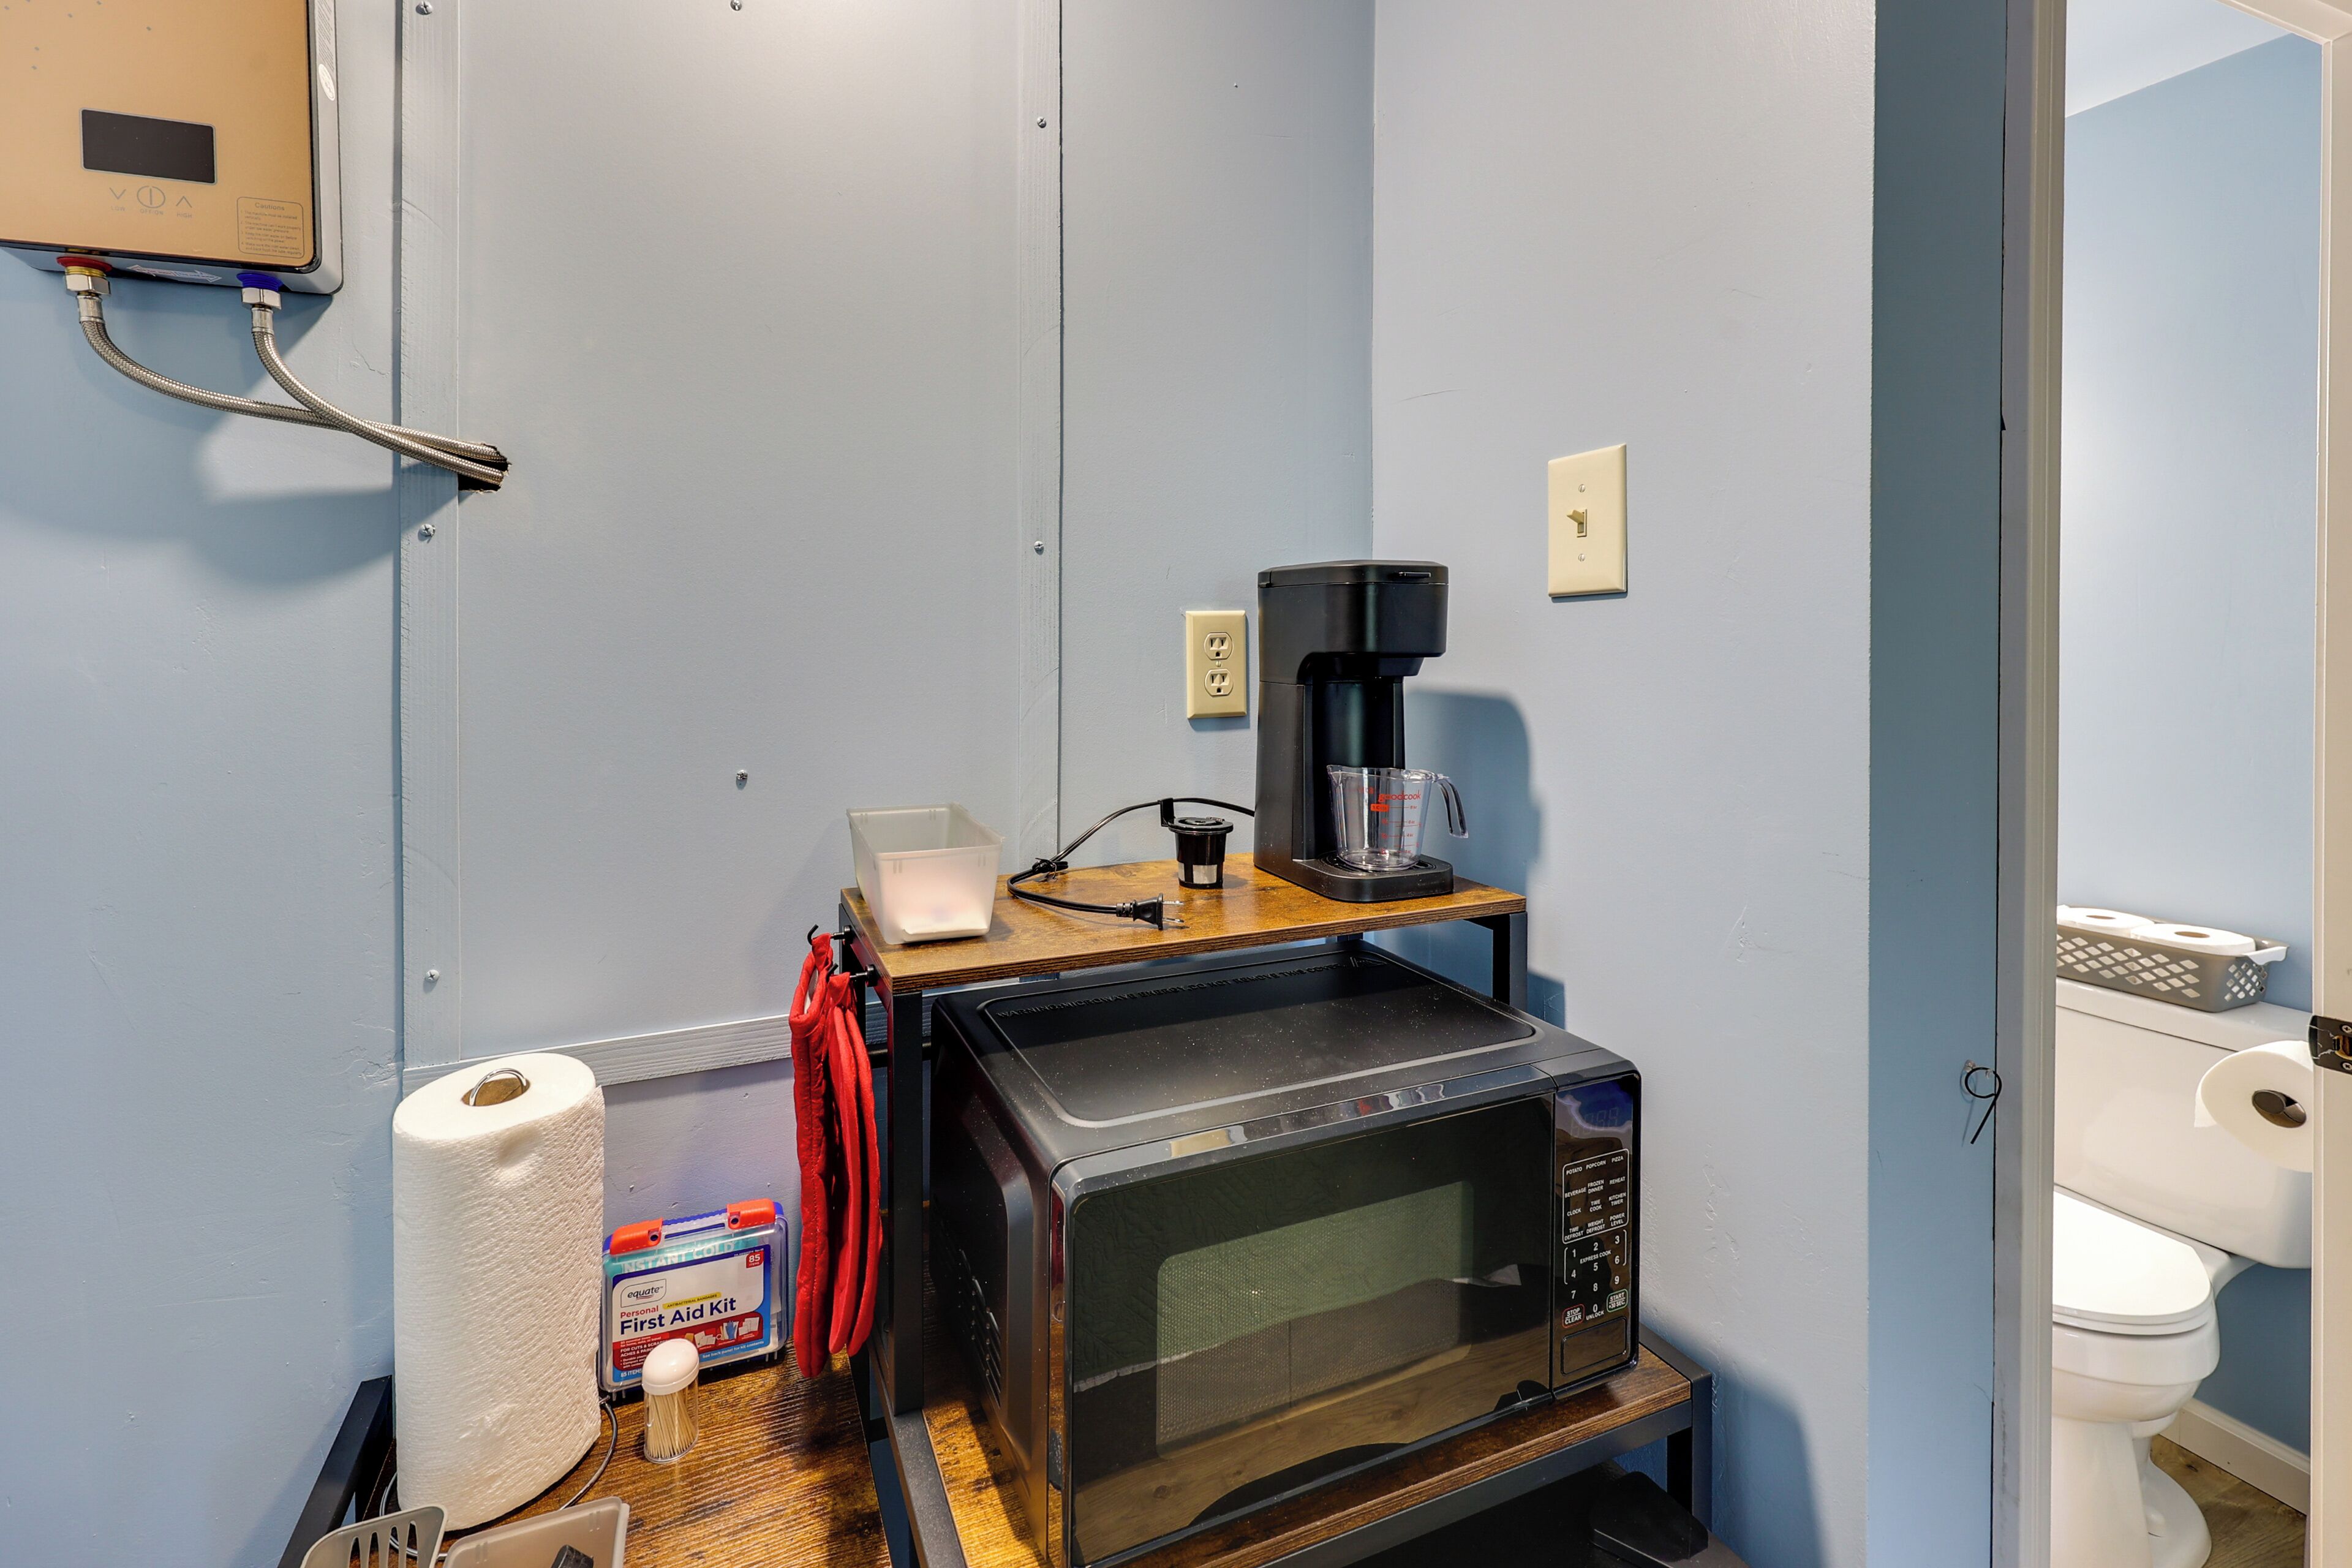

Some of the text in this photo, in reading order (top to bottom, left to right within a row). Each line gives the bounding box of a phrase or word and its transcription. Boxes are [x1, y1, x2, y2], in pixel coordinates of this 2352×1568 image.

[254, 202, 285, 211] Cautions
[1378, 790, 1421, 802] goodcook
[1586, 1160, 1607, 1170] POPCORN
[1566, 1167, 1582, 1175] POTATO
[1588, 1179, 1604, 1188] FROZEN
[1609, 1177, 1626, 1185] REHEAT
[1564, 1186, 1586, 1198] BEVERAGE
[1588, 1185, 1604, 1194] DINNER
[1608, 1192, 1626, 1201] KITCHEN
[1567, 1208, 1581, 1216] CLOCK
[1610, 1212, 1625, 1221] POWER
[1588, 1219, 1604, 1228] WEIGHT
[1586, 1224, 1605, 1234] DEFROST
[1564, 1231, 1584, 1241] DEFROST
[1615, 1235, 1620, 1244] 3
[1593, 1242, 1598, 1251] 2
[622, 1251, 687, 1273] INSTANT
[693, 1242, 735, 1259] COLD
[1572, 1249, 1576, 1257] 1
[1580, 1250, 1611, 1264] EXPRESS COOK
[748, 1254, 760, 1263] 85
[1615, 1256, 1620, 1264] 6
[1593, 1262, 1598, 1272] 5
[1571, 1269, 1576, 1278] 4
[1615, 1275, 1619, 1284] 9
[1593, 1283, 1598, 1292] 8
[627, 1286, 660, 1299] equate
[1571, 1290, 1576, 1299] 7
[1610, 1292, 1625, 1302] START
[620, 1305, 658, 1319] Personal
[666, 1298, 696, 1308] ANTIBACTERIAL
[1567, 1307, 1580, 1316] STOP
[1593, 1304, 1598, 1313] 0
[620, 1298, 736, 1335] First Aid Kit
[1565, 1314, 1581, 1325] CLEAR
[1586, 1310, 1605, 1321] UNLOCK
